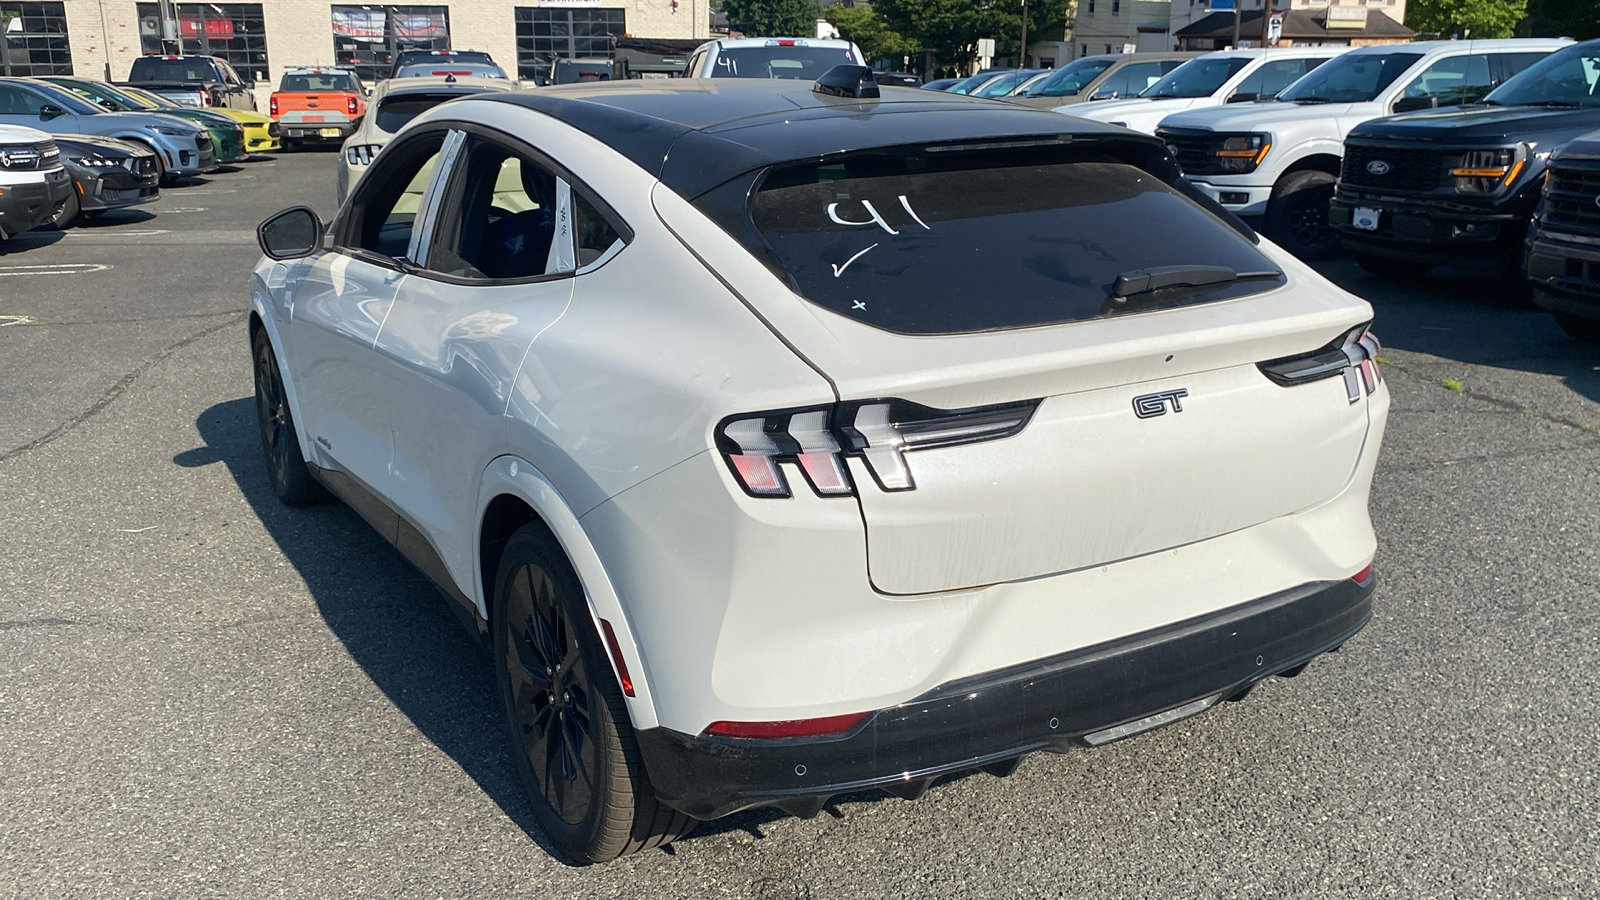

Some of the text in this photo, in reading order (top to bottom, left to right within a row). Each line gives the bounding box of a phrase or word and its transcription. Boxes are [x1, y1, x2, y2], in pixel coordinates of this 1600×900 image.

[718, 56, 738, 76] 41
[827, 195, 931, 235] 41
[1131, 387, 1189, 419] GT
